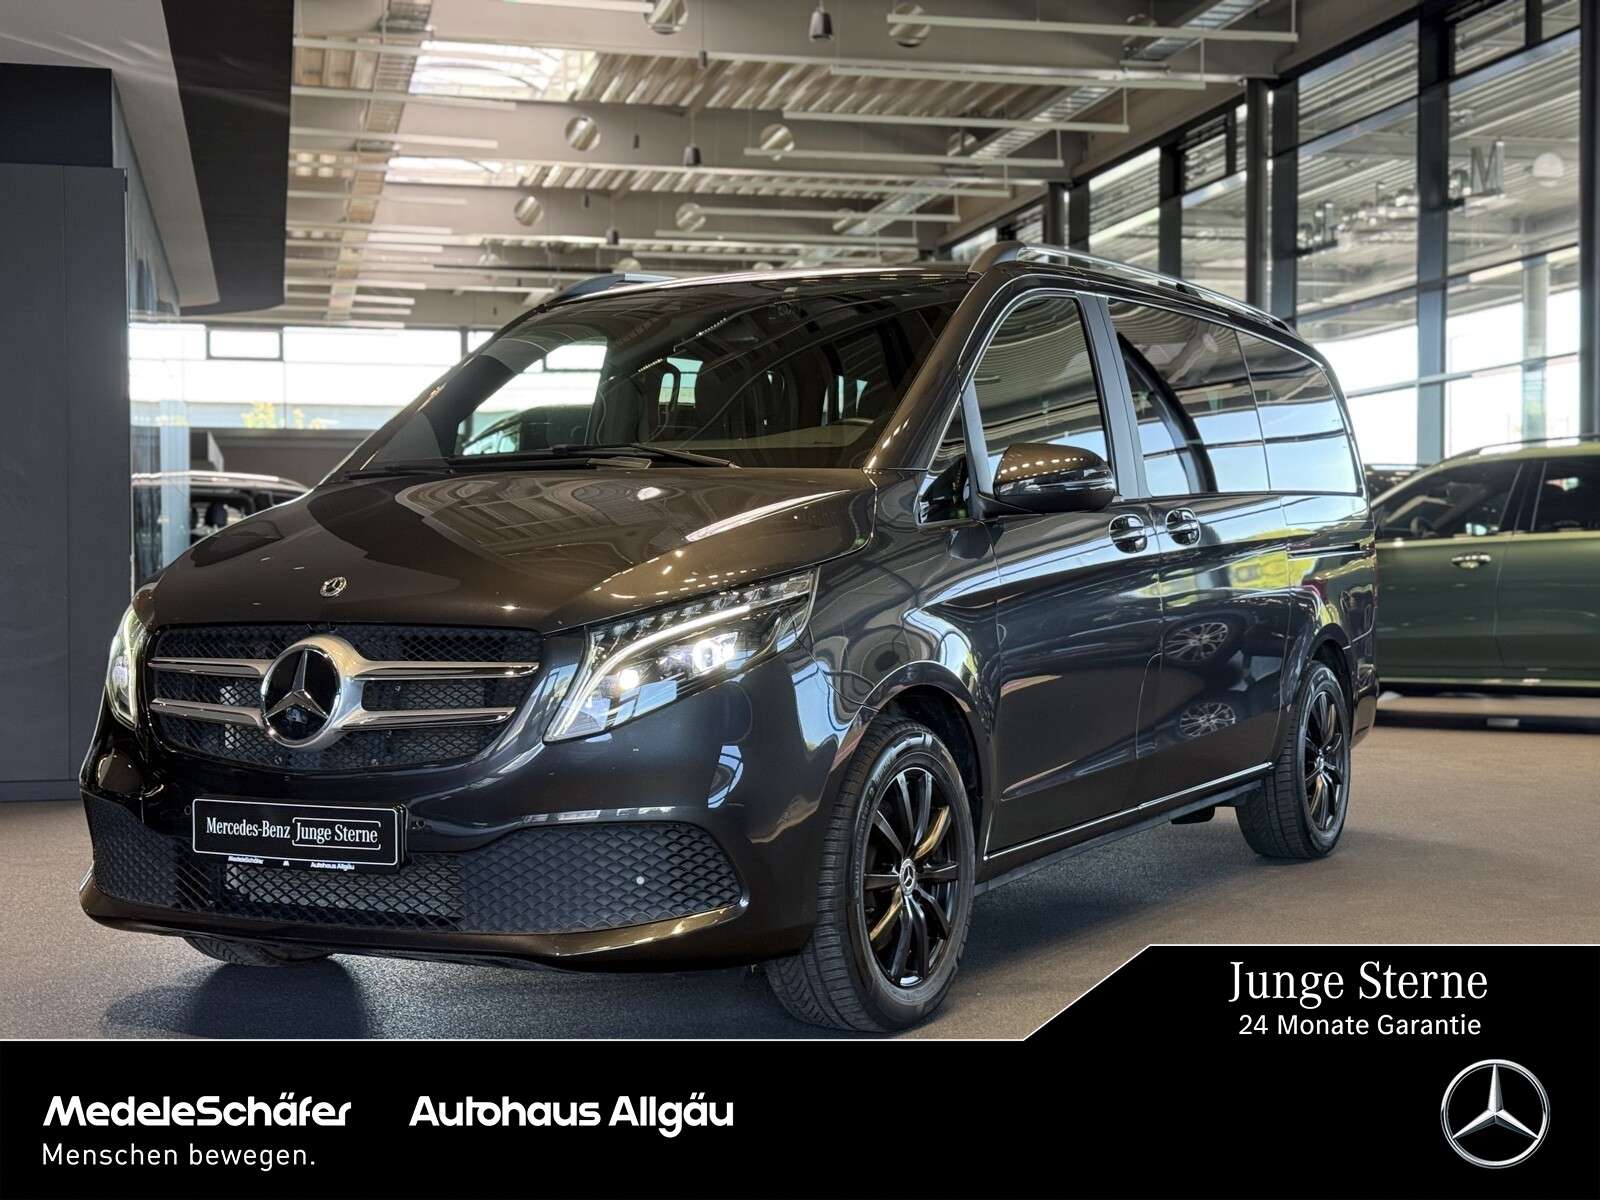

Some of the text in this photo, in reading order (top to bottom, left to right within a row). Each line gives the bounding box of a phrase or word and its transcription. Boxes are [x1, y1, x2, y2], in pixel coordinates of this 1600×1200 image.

[206, 816, 378, 844] Mercedes-Benz Junge Sterne
